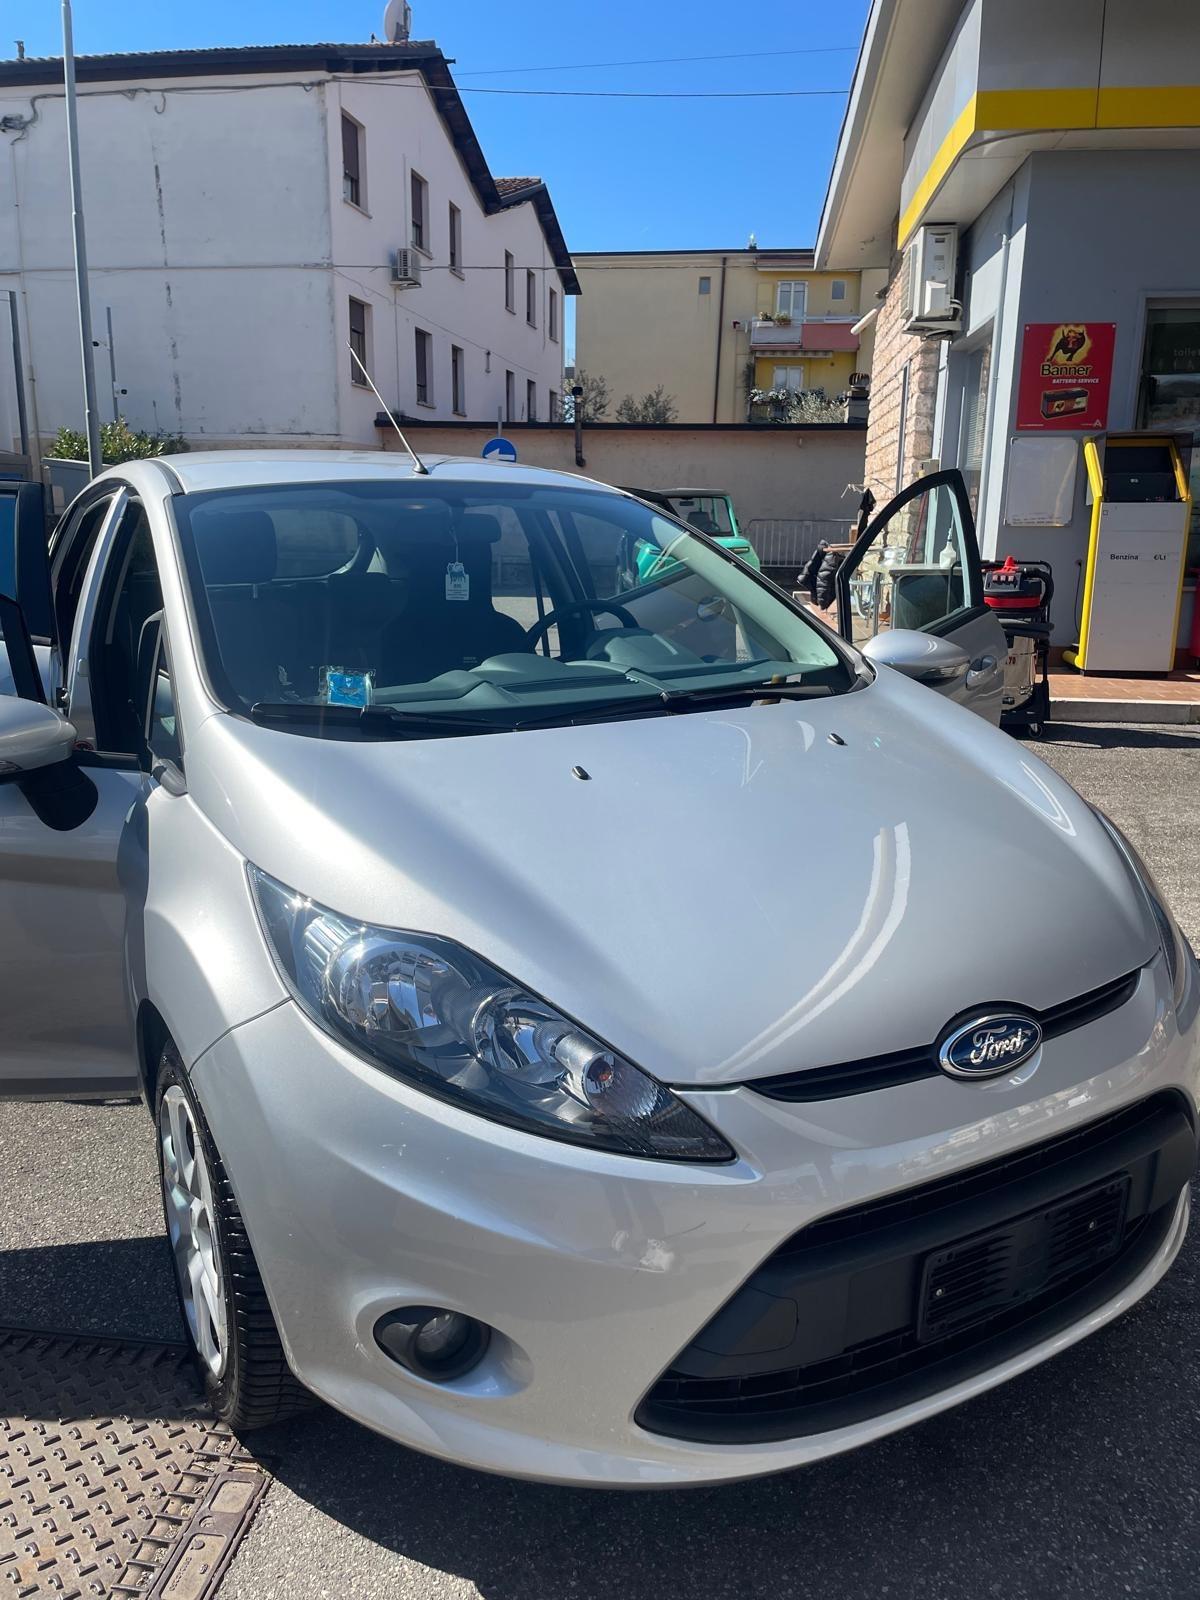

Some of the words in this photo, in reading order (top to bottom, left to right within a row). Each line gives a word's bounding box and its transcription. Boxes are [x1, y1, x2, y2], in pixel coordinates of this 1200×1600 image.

[1040, 363, 1092, 377] Banner
[1110, 553, 1138, 561] Benzina
[969, 1024, 1026, 1066] Ford
